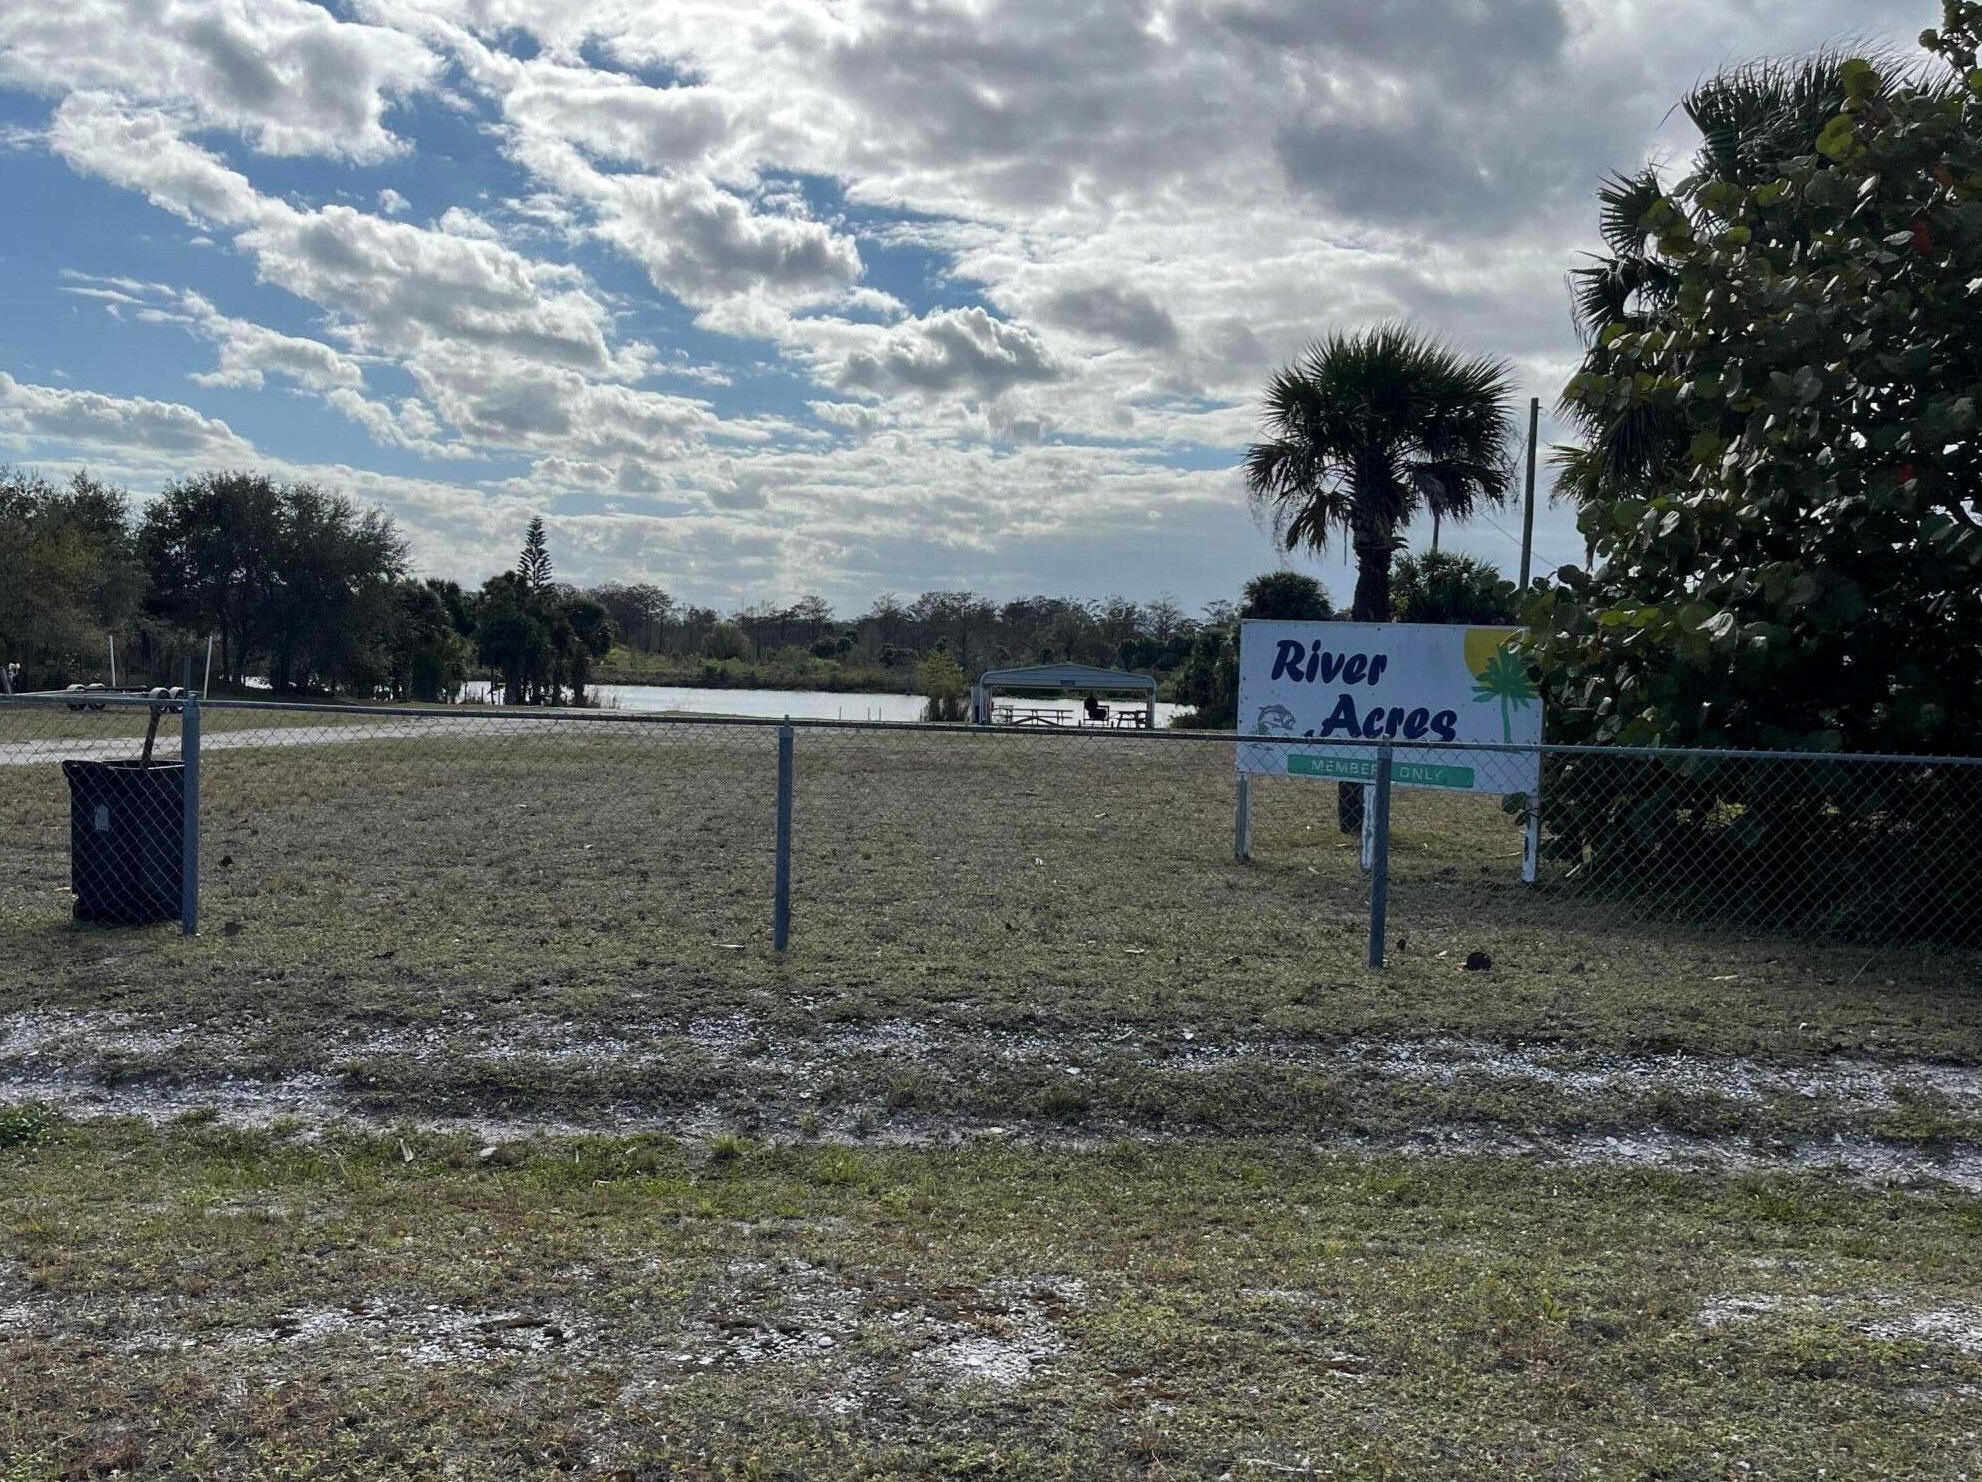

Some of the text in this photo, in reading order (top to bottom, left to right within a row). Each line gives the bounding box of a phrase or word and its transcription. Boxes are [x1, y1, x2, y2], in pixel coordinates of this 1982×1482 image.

[1271, 639, 1387, 686] River
[1306, 693, 1457, 742] Acres
[1311, 759, 1443, 780] MEMBER ONLY
